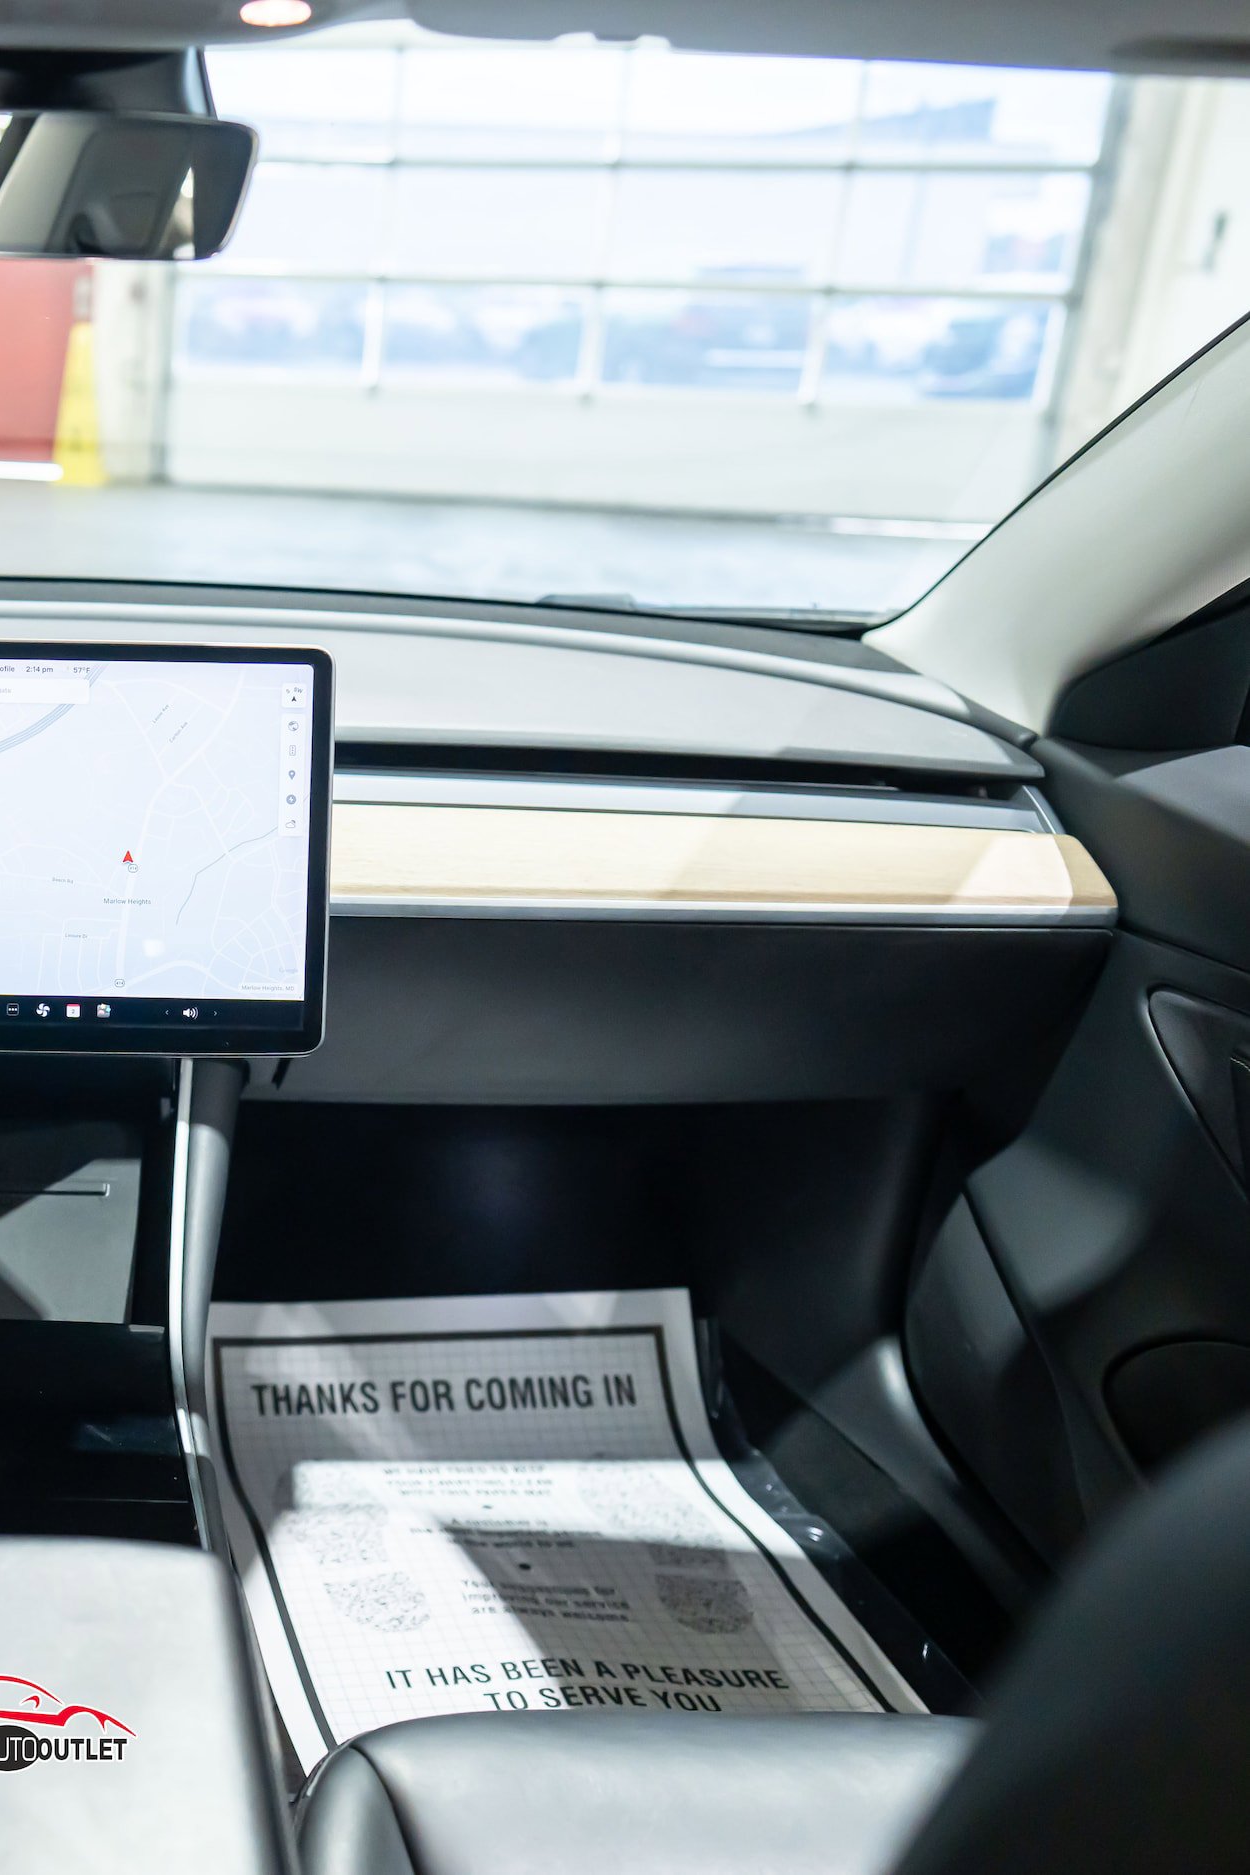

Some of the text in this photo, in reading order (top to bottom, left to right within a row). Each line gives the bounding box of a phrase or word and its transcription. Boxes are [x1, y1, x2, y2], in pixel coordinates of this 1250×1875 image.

[127, 898, 152, 906] Heights
[251, 1374, 637, 1417] THANKS FOR COMING IN
[385, 1657, 790, 1690] IT HAS BEEN A PLEASURE
[482, 1685, 723, 1712] TO SERVE YOU
